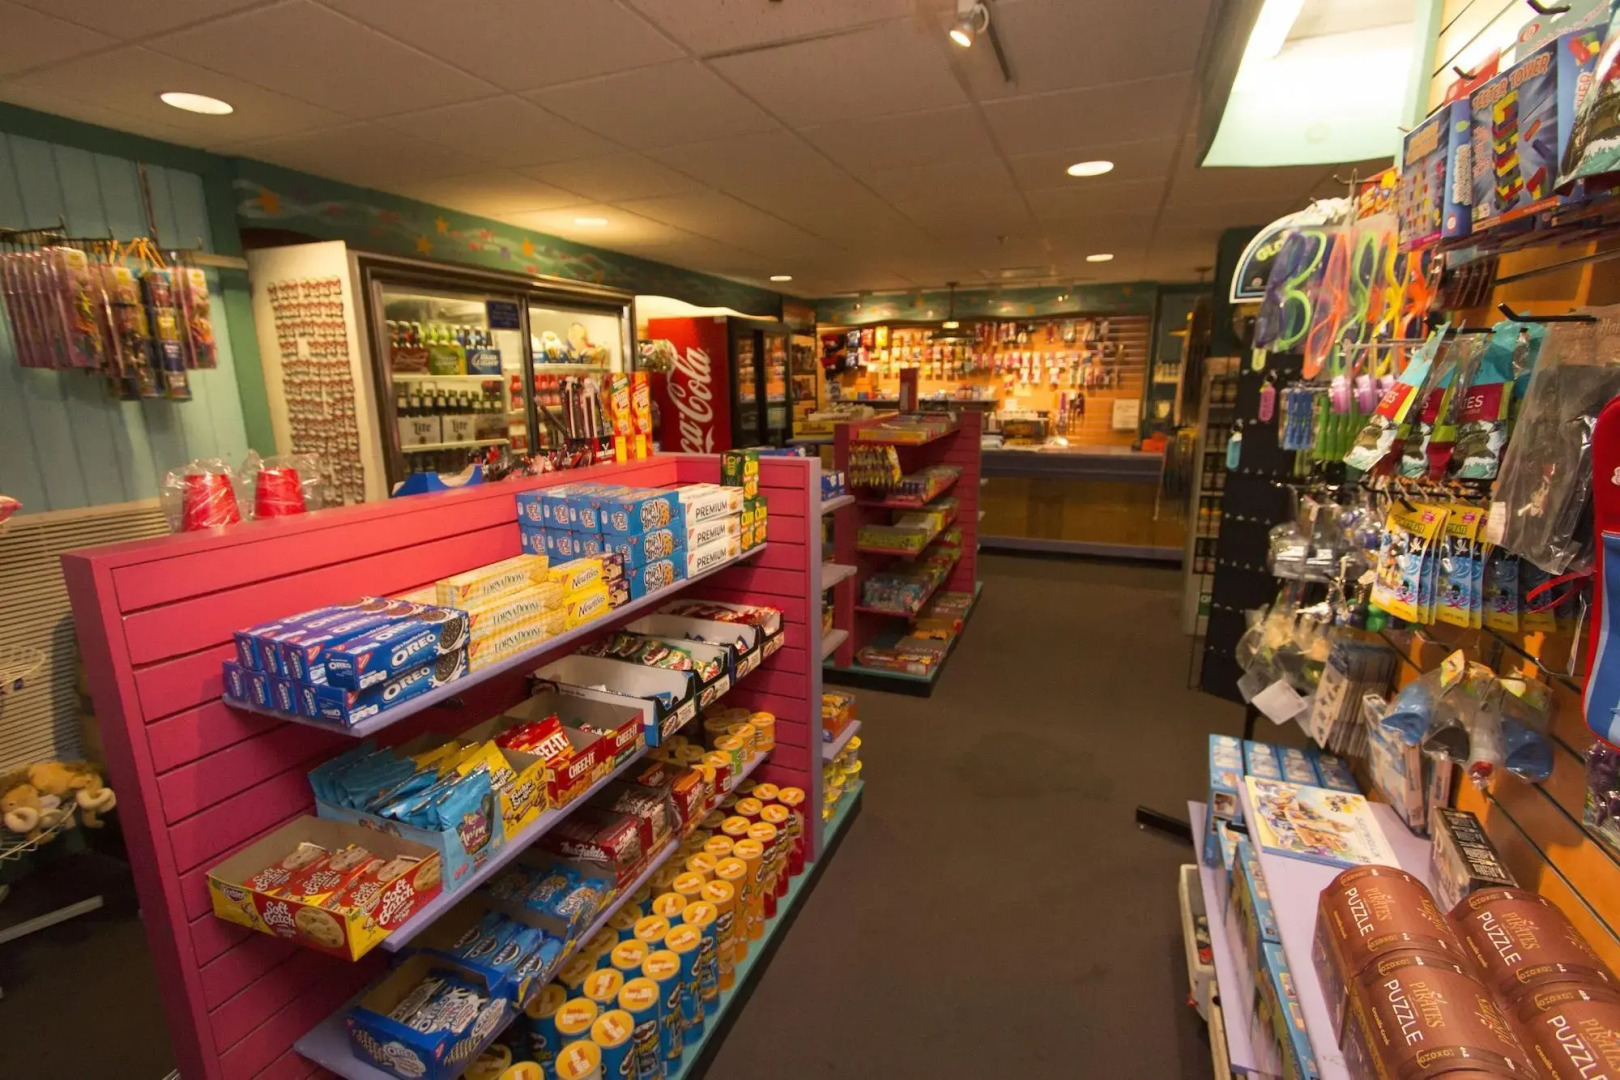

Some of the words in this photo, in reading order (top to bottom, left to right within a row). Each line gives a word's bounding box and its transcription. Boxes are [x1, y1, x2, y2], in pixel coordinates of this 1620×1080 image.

[1510, 53, 1550, 90] TOWER
[695, 499, 728, 518] PREMIUM
[697, 525, 726, 543] PREMIUM
[697, 548, 727, 568] PREMIUM
[572, 567, 599, 590] Newtons
[579, 594, 606, 617] Newtons
[328, 661, 352, 670] OREO
[391, 633, 436, 668] OREO
[383, 667, 431, 702] OREO
[616, 723, 638, 747] CHEEZ-IT
[569, 752, 596, 779] CHEEZ-IT
[266, 902, 289, 915] Soft
[380, 887, 415, 925] Batch
[383, 879, 408, 909] Soft
[1364, 888, 1392, 921] PIRATES
[264, 912, 296, 927] Batch
[1345, 887, 1374, 936] PUZZLE
[1477, 911, 1522, 966] PUZZLE
[1502, 912, 1540, 950] PIRATES
[1384, 979, 1424, 1046] PUZZLE
[1410, 982, 1445, 1027] PIRATES
[1547, 1015, 1608, 1080] PUZZL
